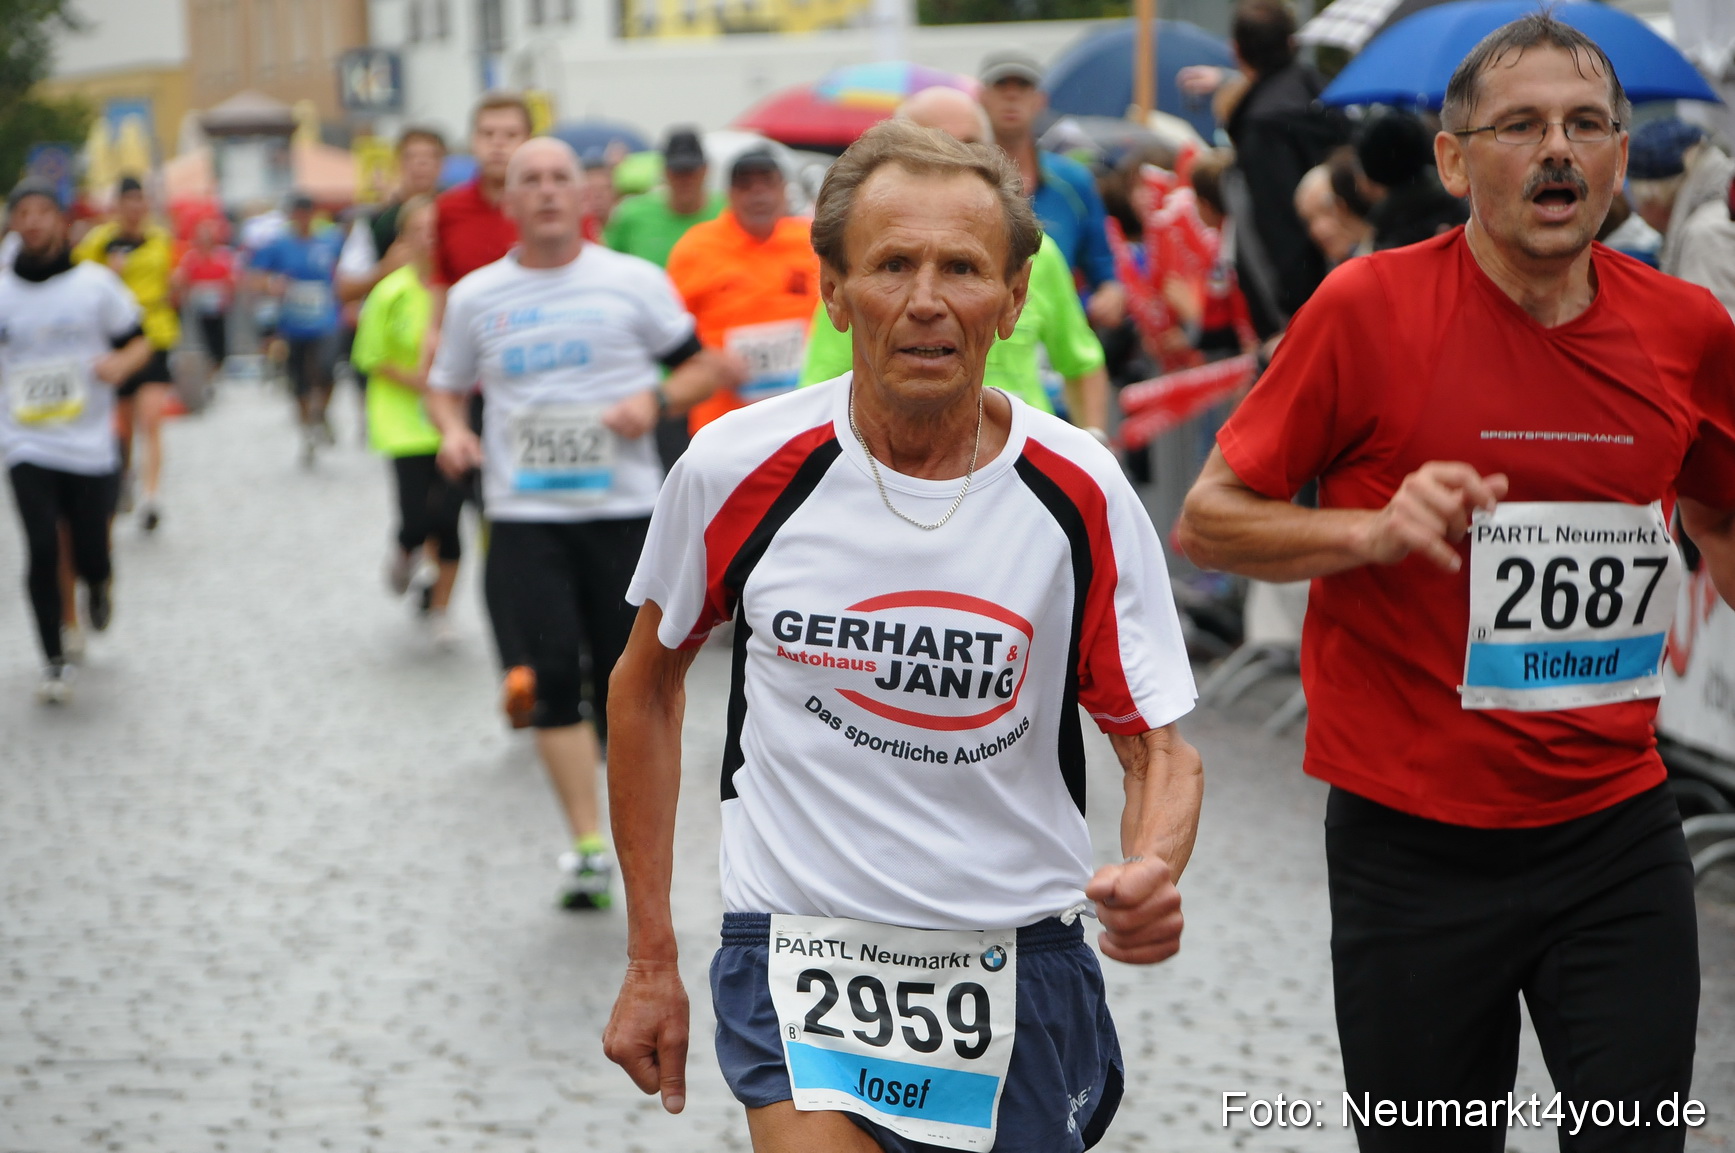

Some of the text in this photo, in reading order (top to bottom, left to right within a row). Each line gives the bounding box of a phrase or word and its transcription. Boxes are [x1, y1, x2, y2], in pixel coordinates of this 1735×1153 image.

[521, 428, 600, 465] 2552
[1480, 430, 1634, 445] SPORTSPERFORMANCE
[1477, 525, 1658, 544] PARTL Neumarkt
[1494, 557, 1669, 630] 2687
[772, 609, 1018, 666] GERHART &
[776, 645, 877, 673] Autohaus
[1523, 648, 1620, 681] Richard
[874, 660, 1014, 699] JÄNIG
[804, 695, 1030, 765] Das sportliche Autohaus
[775, 937, 853, 960] PARTL
[859, 943, 971, 970] Neumarkt
[796, 968, 992, 1060] 2959
[854, 1068, 932, 1110] Josef
